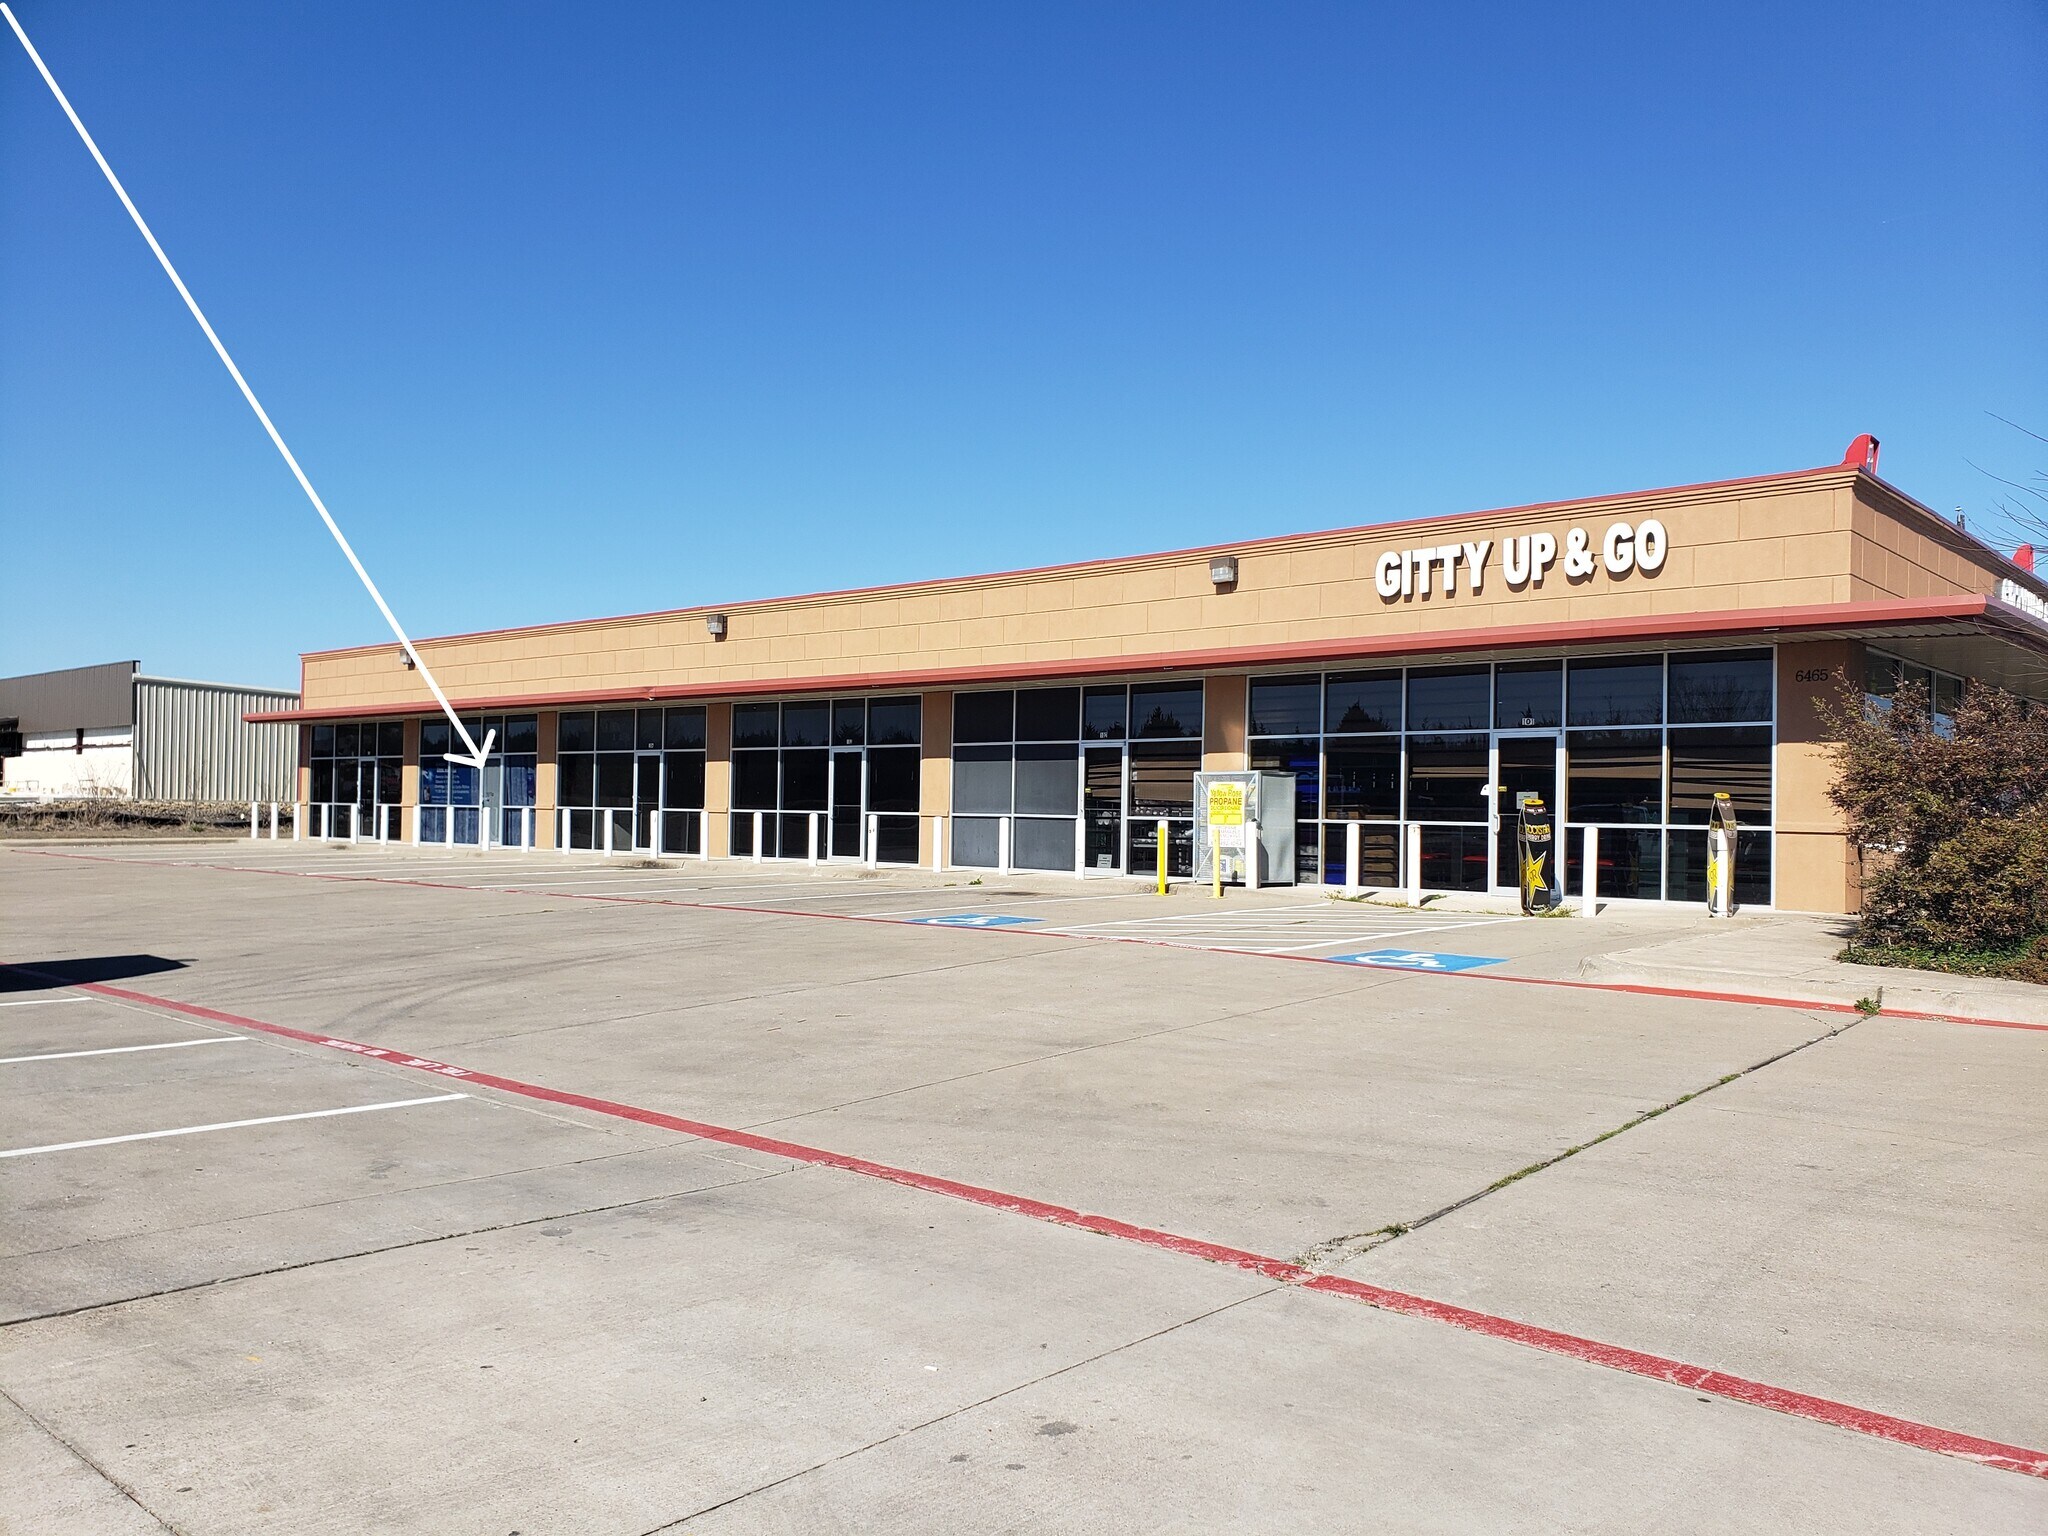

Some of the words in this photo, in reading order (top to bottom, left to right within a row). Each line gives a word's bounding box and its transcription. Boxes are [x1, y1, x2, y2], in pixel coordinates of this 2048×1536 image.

[1375, 540, 1493, 598] GITTY
[1503, 532, 1557, 585] UP
[1564, 527, 1596, 578] &
[1603, 519, 1667, 574] GO
[1795, 669, 1829, 682] 6465
[1210, 797, 1242, 805] PROPANE
